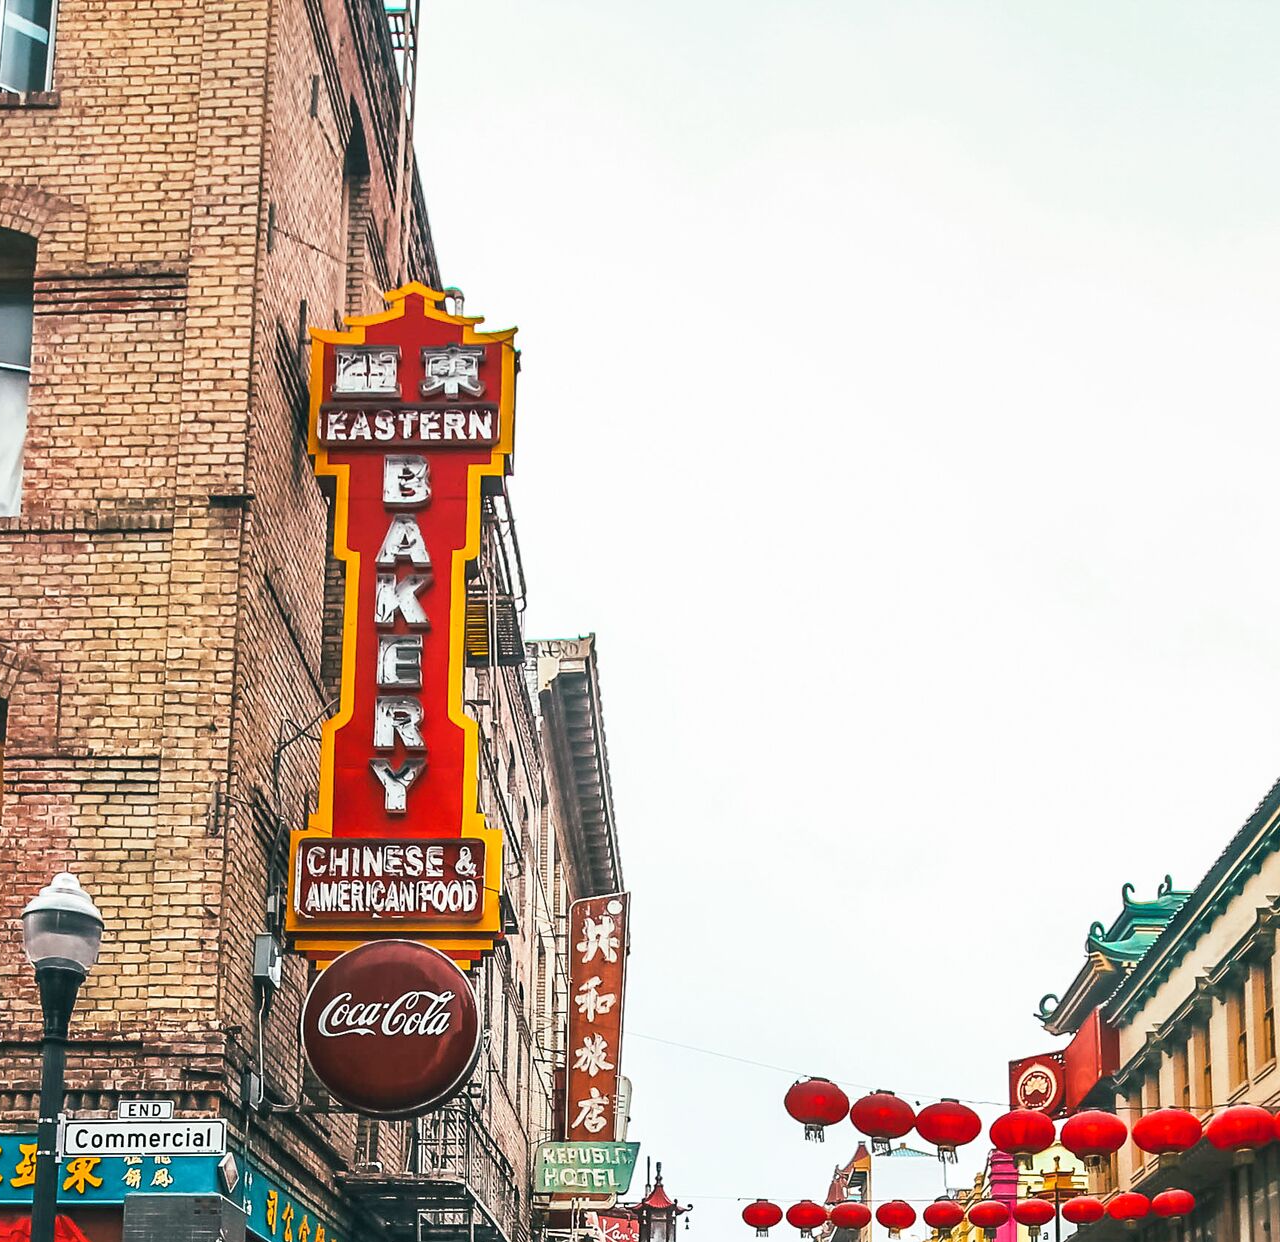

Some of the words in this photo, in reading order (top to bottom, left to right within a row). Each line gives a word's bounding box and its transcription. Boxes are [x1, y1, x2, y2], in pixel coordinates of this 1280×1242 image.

[326, 409, 492, 441] EASTERN
[369, 454, 431, 813] BAKERY
[306, 846, 444, 877] CHINESE
[455, 846, 477, 877] &
[305, 880, 417, 912] AMERICAN
[419, 880, 477, 912] FOOD
[318, 991, 456, 1037] Coca-Cola
[571, 914, 620, 1133] 共和旅店
[128, 1104, 161, 1117] END
[75, 1127, 212, 1149] Commercial
[544, 1168, 621, 1187] HOTEL
